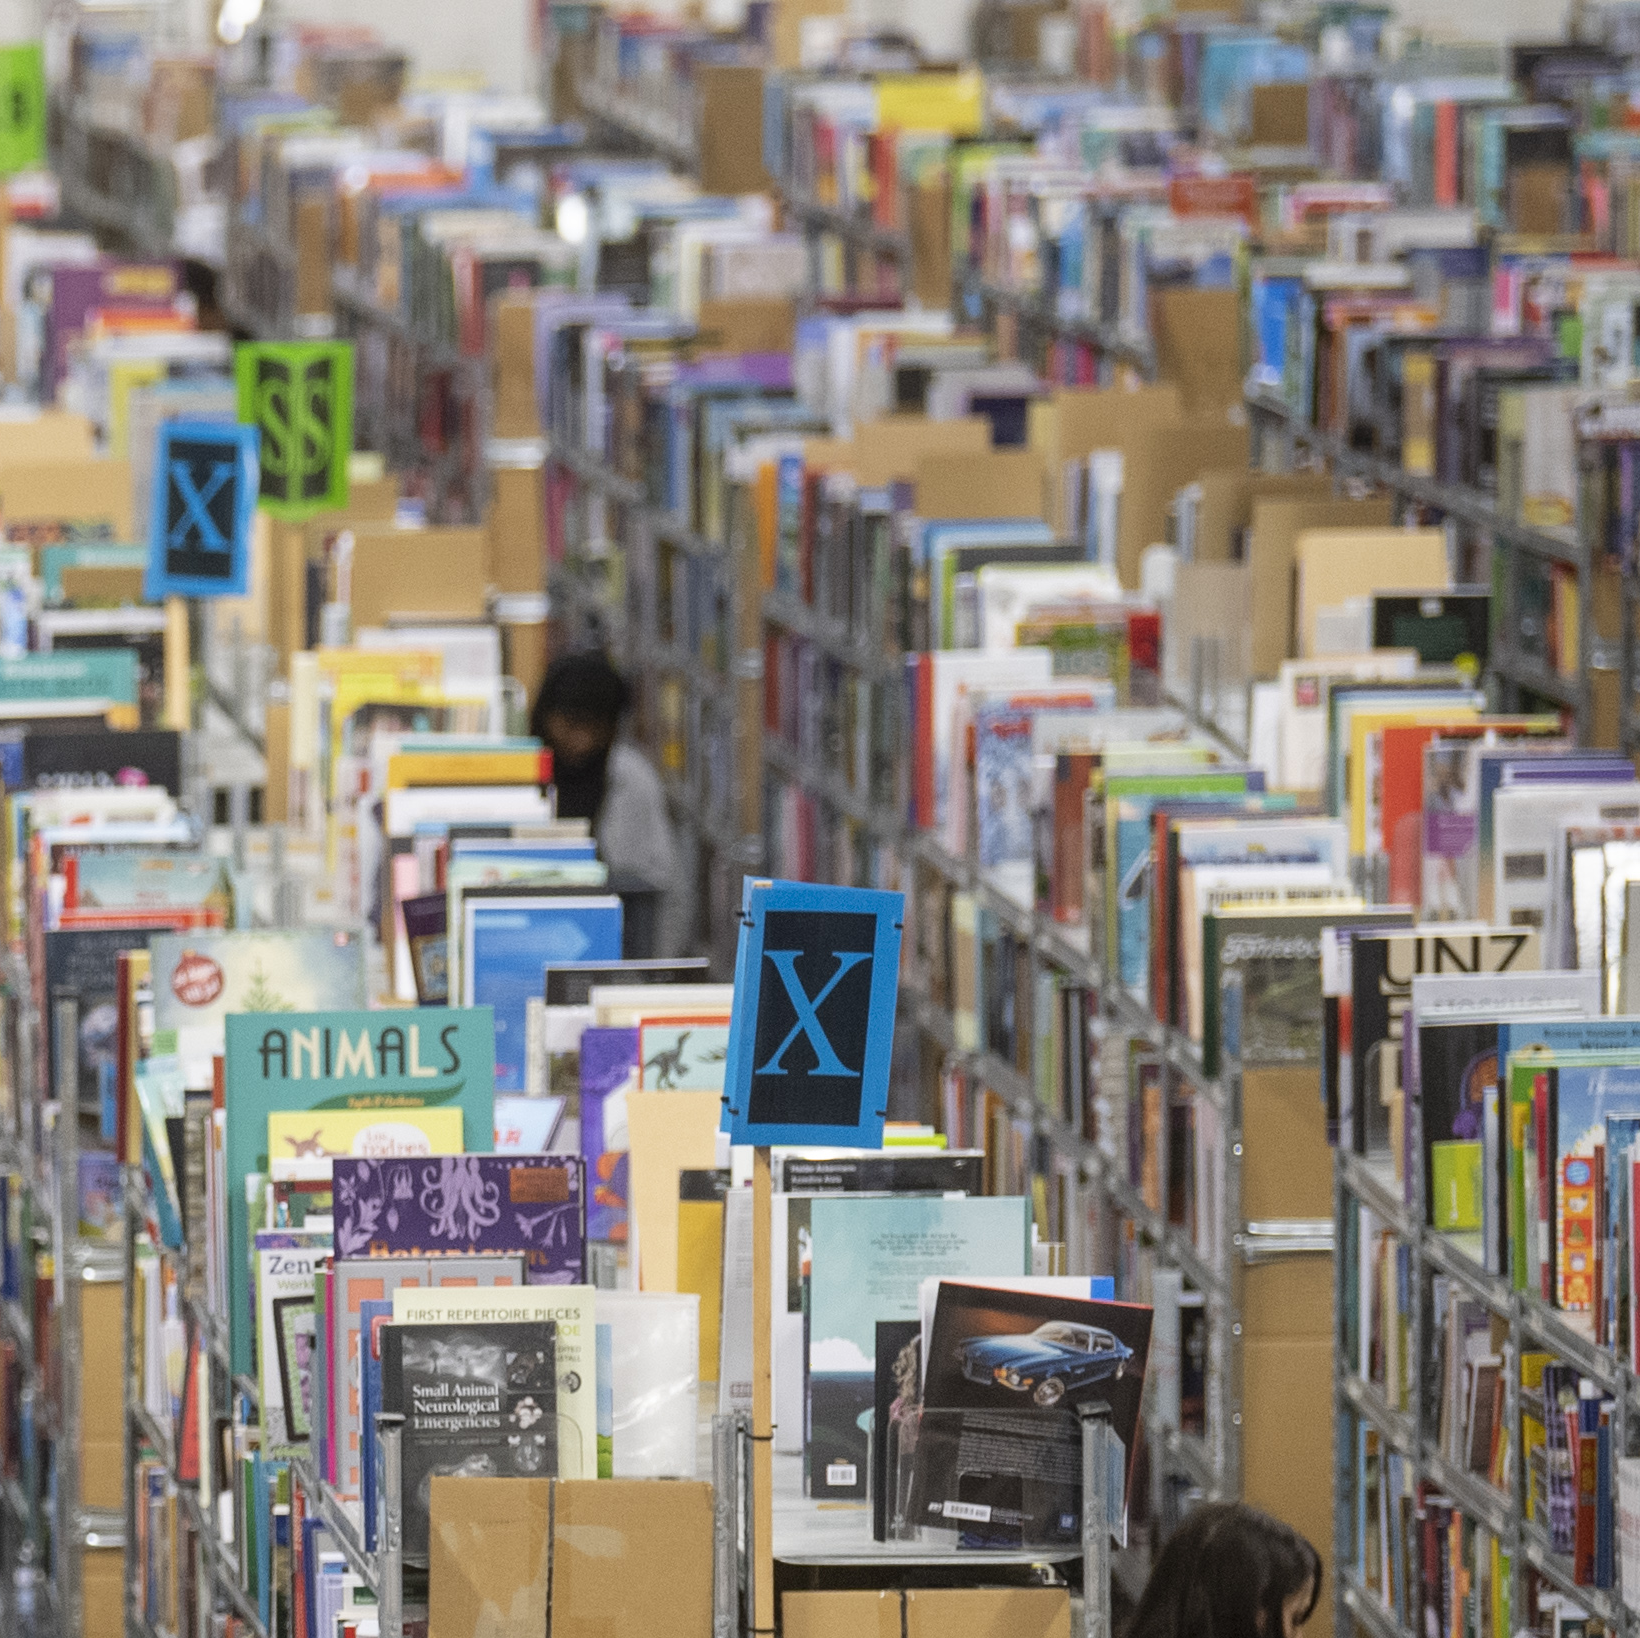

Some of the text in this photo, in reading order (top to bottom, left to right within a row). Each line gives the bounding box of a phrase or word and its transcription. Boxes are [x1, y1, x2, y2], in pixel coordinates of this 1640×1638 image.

[171, 460, 234, 549] X
[755, 950, 873, 1077] X
[259, 1024, 461, 1080] ANIMALS
[269, 1256, 311, 1275] Zen
[406, 1307, 582, 1321] FIRST REPERTOIRE PIECES
[412, 1382, 500, 1398] Small Animal
[413, 1397, 501, 1416] Neurological
[413, 1416, 501, 1433] Emergencies
